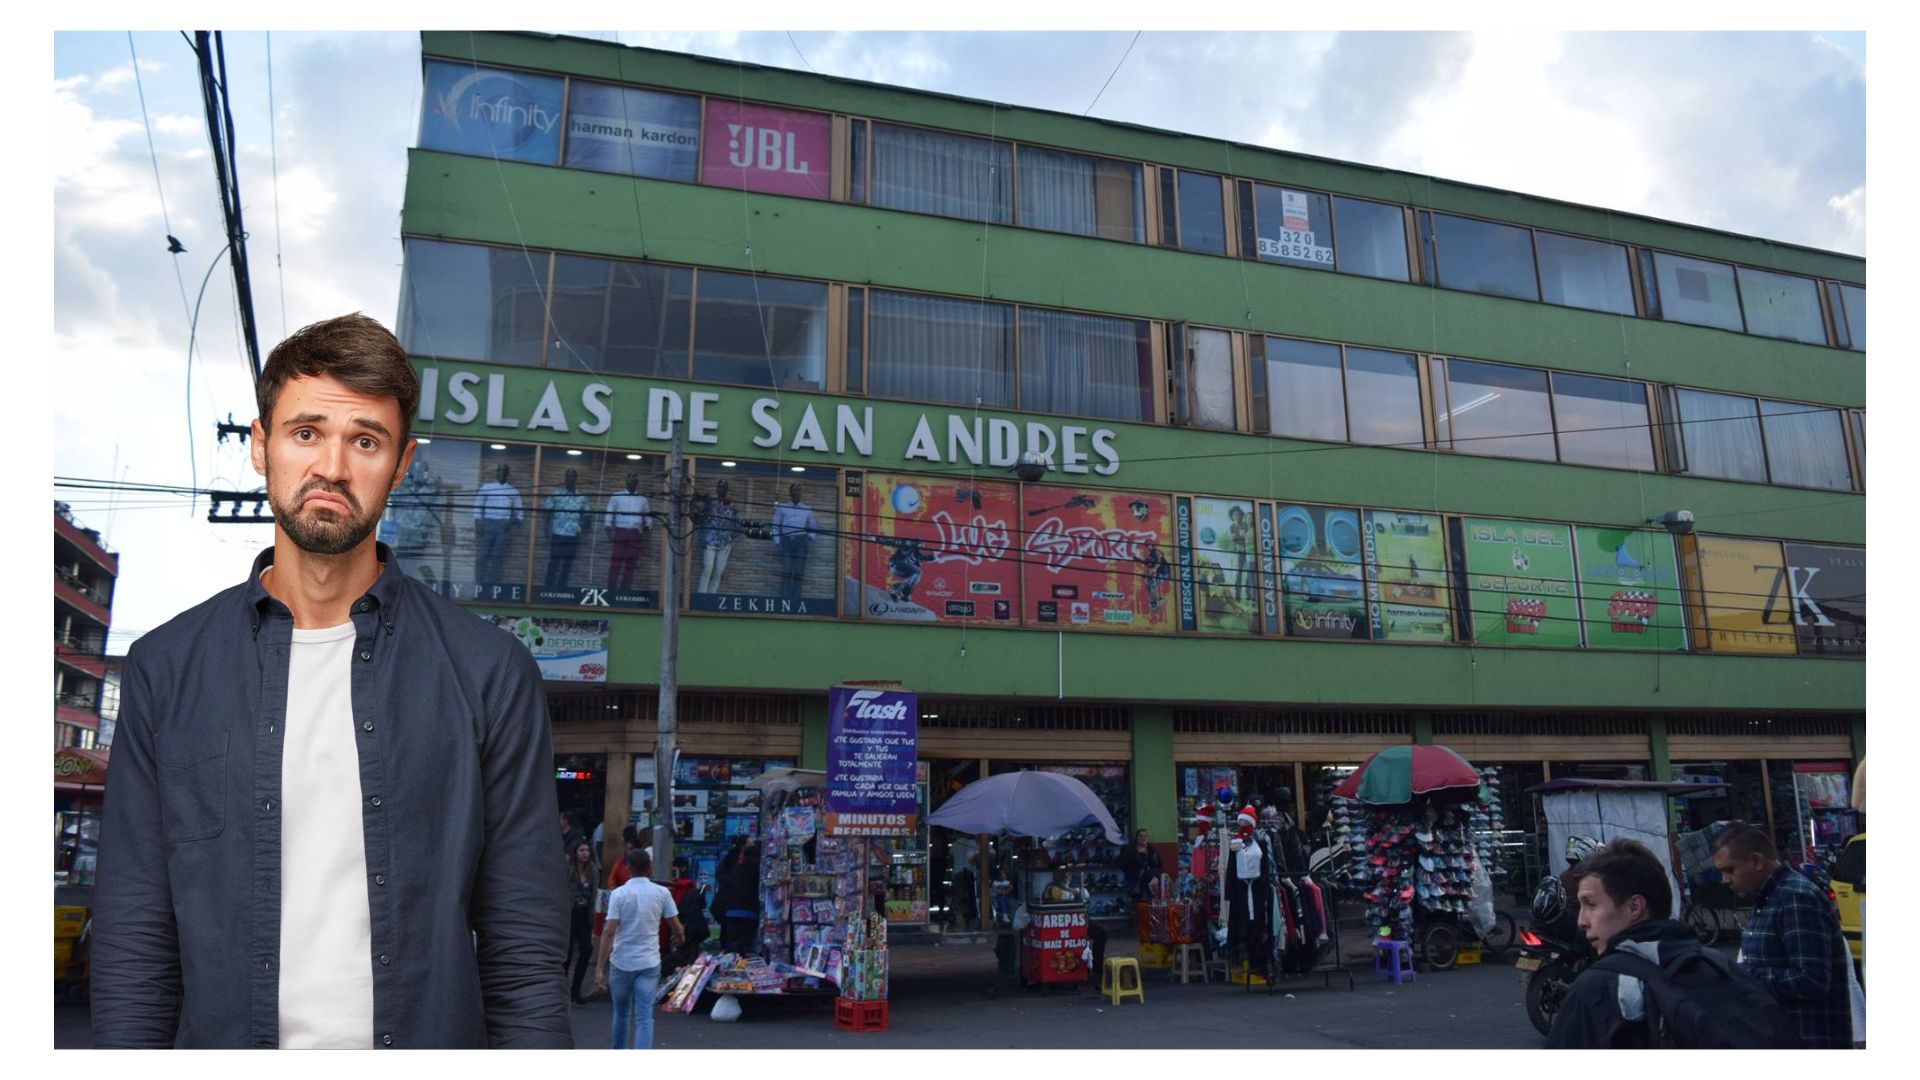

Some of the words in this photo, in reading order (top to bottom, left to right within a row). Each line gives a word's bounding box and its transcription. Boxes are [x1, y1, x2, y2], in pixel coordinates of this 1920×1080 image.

[571, 119, 633, 140] harman
[641, 127, 698, 147] kardon
[729, 124, 809, 175] JBL
[1283, 231, 1312, 246] 320
[1259, 241, 1333, 262] 8585262
[419, 367, 613, 435] ISLAS
[647, 387, 719, 444] DE
[751, 397, 874, 456] SAN
[904, 413, 1121, 476] ANDRES
[1179, 506, 1190, 548] AUDIO
[1471, 525, 1517, 543] ISLA
[1524, 529, 1563, 547] DEL
[1261, 519, 1274, 572] AUDIO
[1364, 521, 1377, 572] AUDIO
[580, 587, 610, 606] ZK
[1181, 553, 1193, 620] PERSONAL
[718, 597, 807, 614] ZEKHNA
[1265, 580, 1276, 616] CAR
[1369, 578, 1381, 628] HOME
[547, 638, 598, 649] DEPORTE
[846, 690, 907, 720] Flash
[902, 738, 915, 746] TUS
[838, 760, 882, 768] TOTALMENTE
[832, 790, 857, 798] FAMILIA
[896, 791, 915, 799] USEN
[839, 814, 906, 825] MINUTOS
[1043, 913, 1086, 928] AREPAS
[1060, 929, 1069, 938] DE
